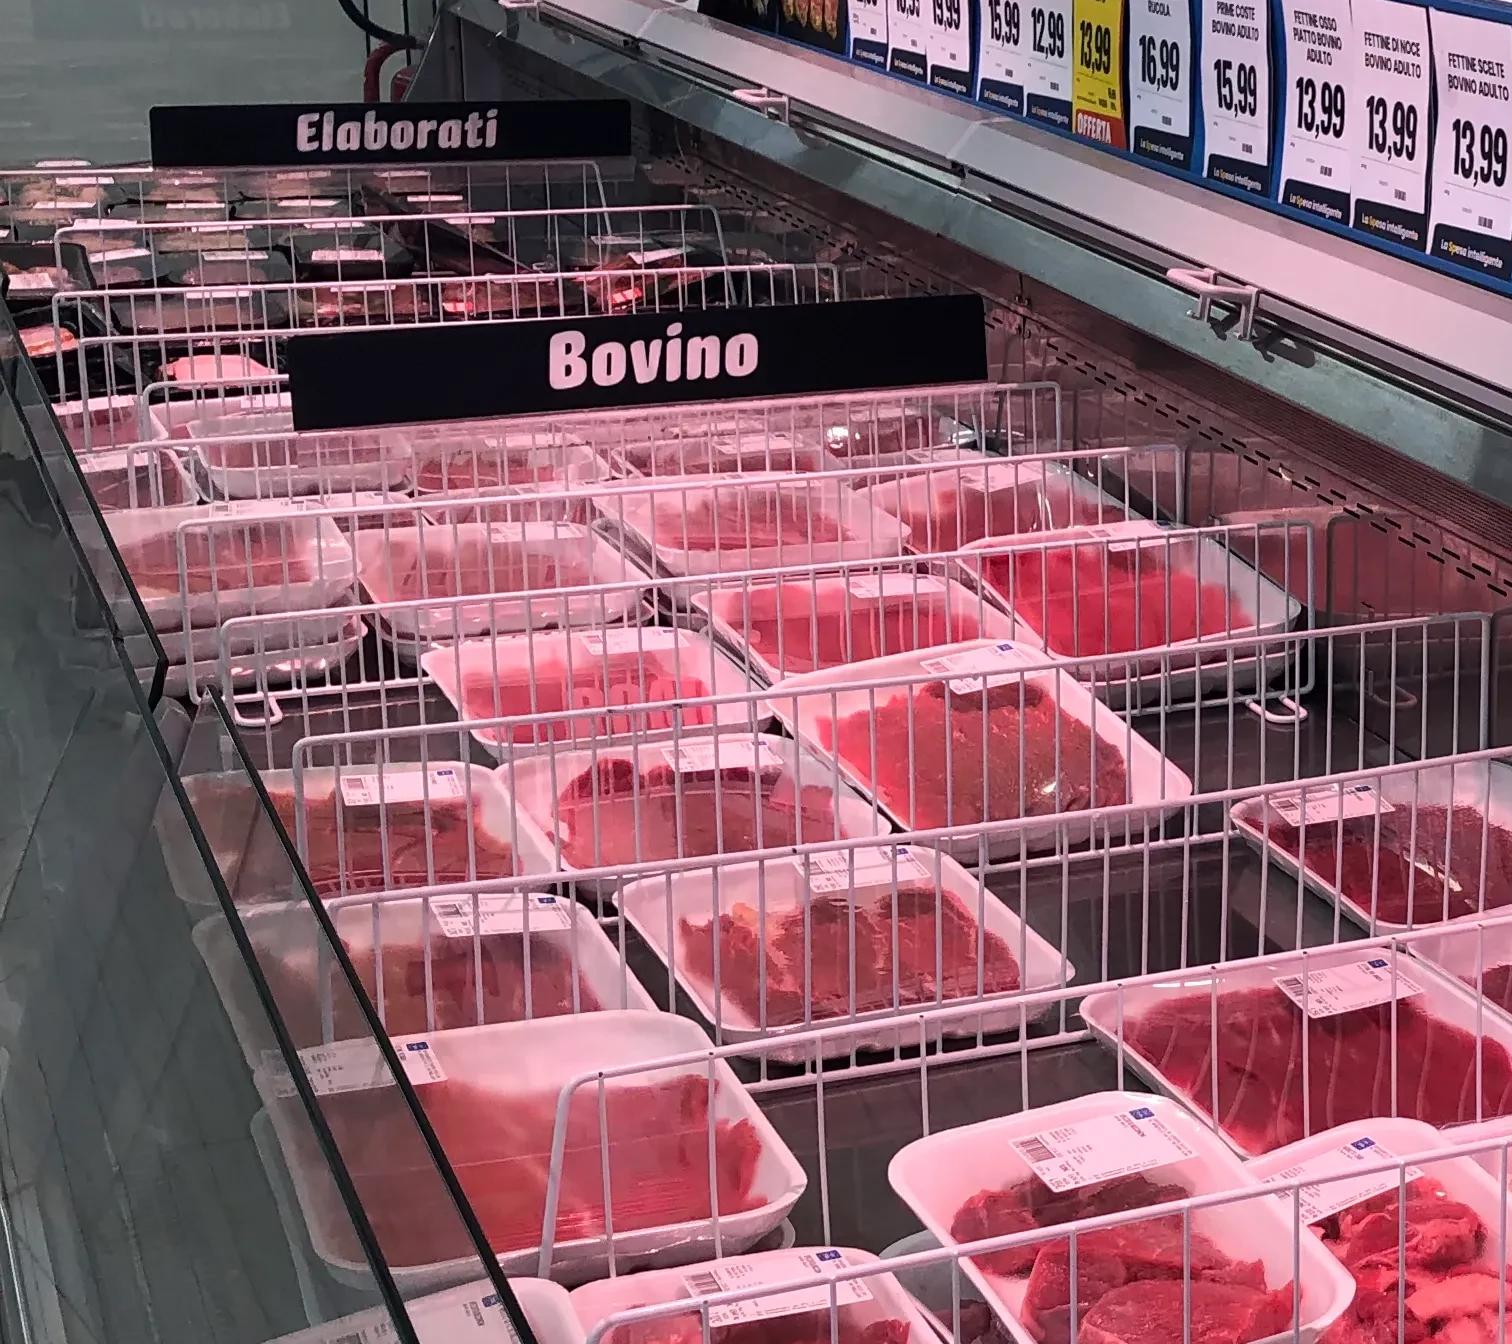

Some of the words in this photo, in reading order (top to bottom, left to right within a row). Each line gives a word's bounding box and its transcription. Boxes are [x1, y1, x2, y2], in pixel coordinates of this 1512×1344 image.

[1148, 0, 1170, 17] RUCOLA
[1216, 1, 1234, 17] PRIME
[1235, 5, 1255, 20] COSTE
[1294, 10, 1318, 28] FETTINE
[1320, 15, 1337, 32] OSSO
[1031, 7, 1065, 60] 12,99
[1212, 20, 1236, 37] BOVINO
[1237, 25, 1259, 42] ADULTO
[1293, 27, 1317, 44] PIATTO
[1317, 33, 1342, 50] BOVINO
[1364, 32, 1391, 51] FETTINE
[1392, 37, 1399, 52] DI
[1400, 38, 1420, 57] NOCE
[1080, 20, 1111, 75] 13,99
[1307, 48, 1332, 66] ADULTO
[1139, 35, 1180, 92] 16,99
[1365, 53, 1392, 72] BOVINO
[1394, 59, 1421, 79] ADULTO
[1448, 53, 1477, 73] FETTINE
[1478, 60, 1505, 79] SCELTE
[1214, 59, 1257, 118] 15,99
[1449, 74, 1477, 95] BOVINO
[1478, 80, 1509, 101] ADULTO
[1296, 76, 1345, 139] 13,99
[296, 109, 499, 153] Elaborati
[1077, 112, 1111, 144] OFFERTA
[1366, 96, 1417, 161] 13,99
[1453, 118, 1507, 188] 13,99
[1440, 239, 1447, 250] La
[1467, 246, 1503, 269] intelligente
[548, 322, 759, 390] Bovino
